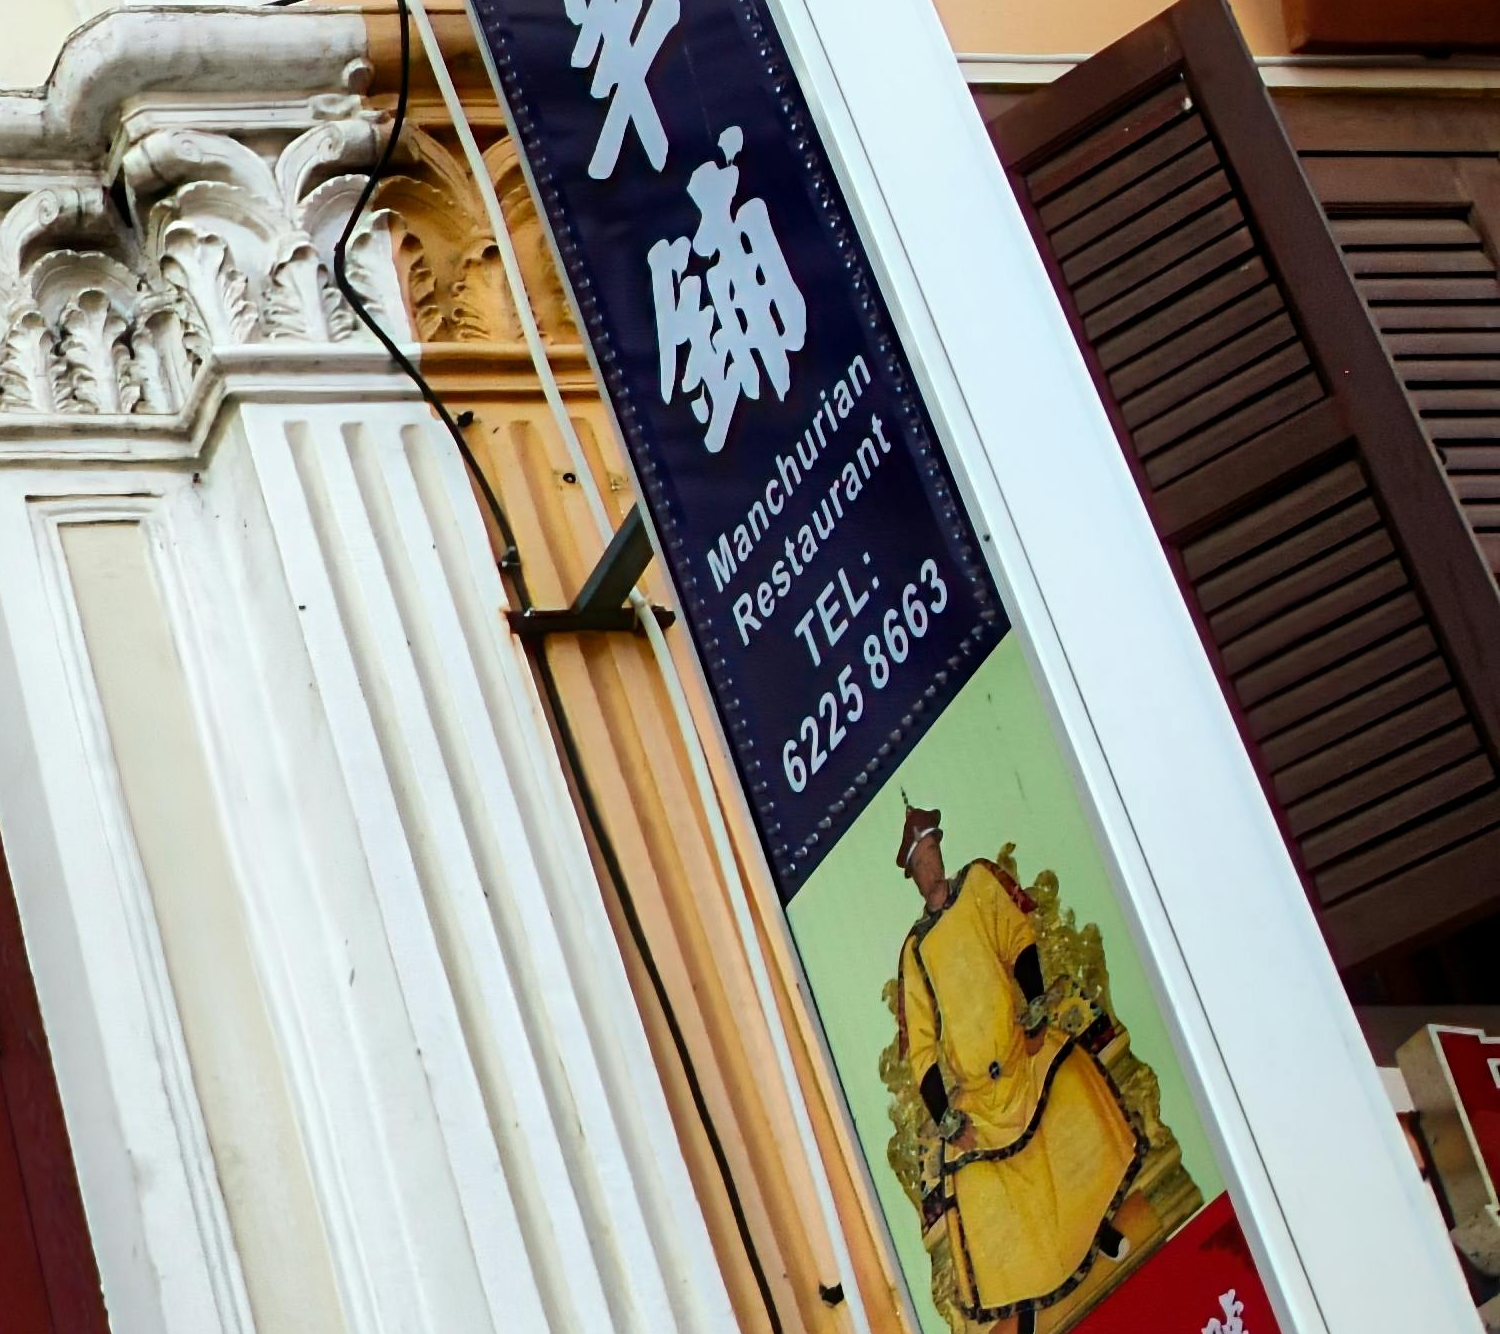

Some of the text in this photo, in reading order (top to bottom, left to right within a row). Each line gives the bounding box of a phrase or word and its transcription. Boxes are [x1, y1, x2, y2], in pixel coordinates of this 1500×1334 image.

[706, 353, 873, 592] Manchurian
[732, 415, 893, 647] Restaurant
[782, 558, 950, 794] 6225 8663
[794, 551, 880, 668] TEL:
